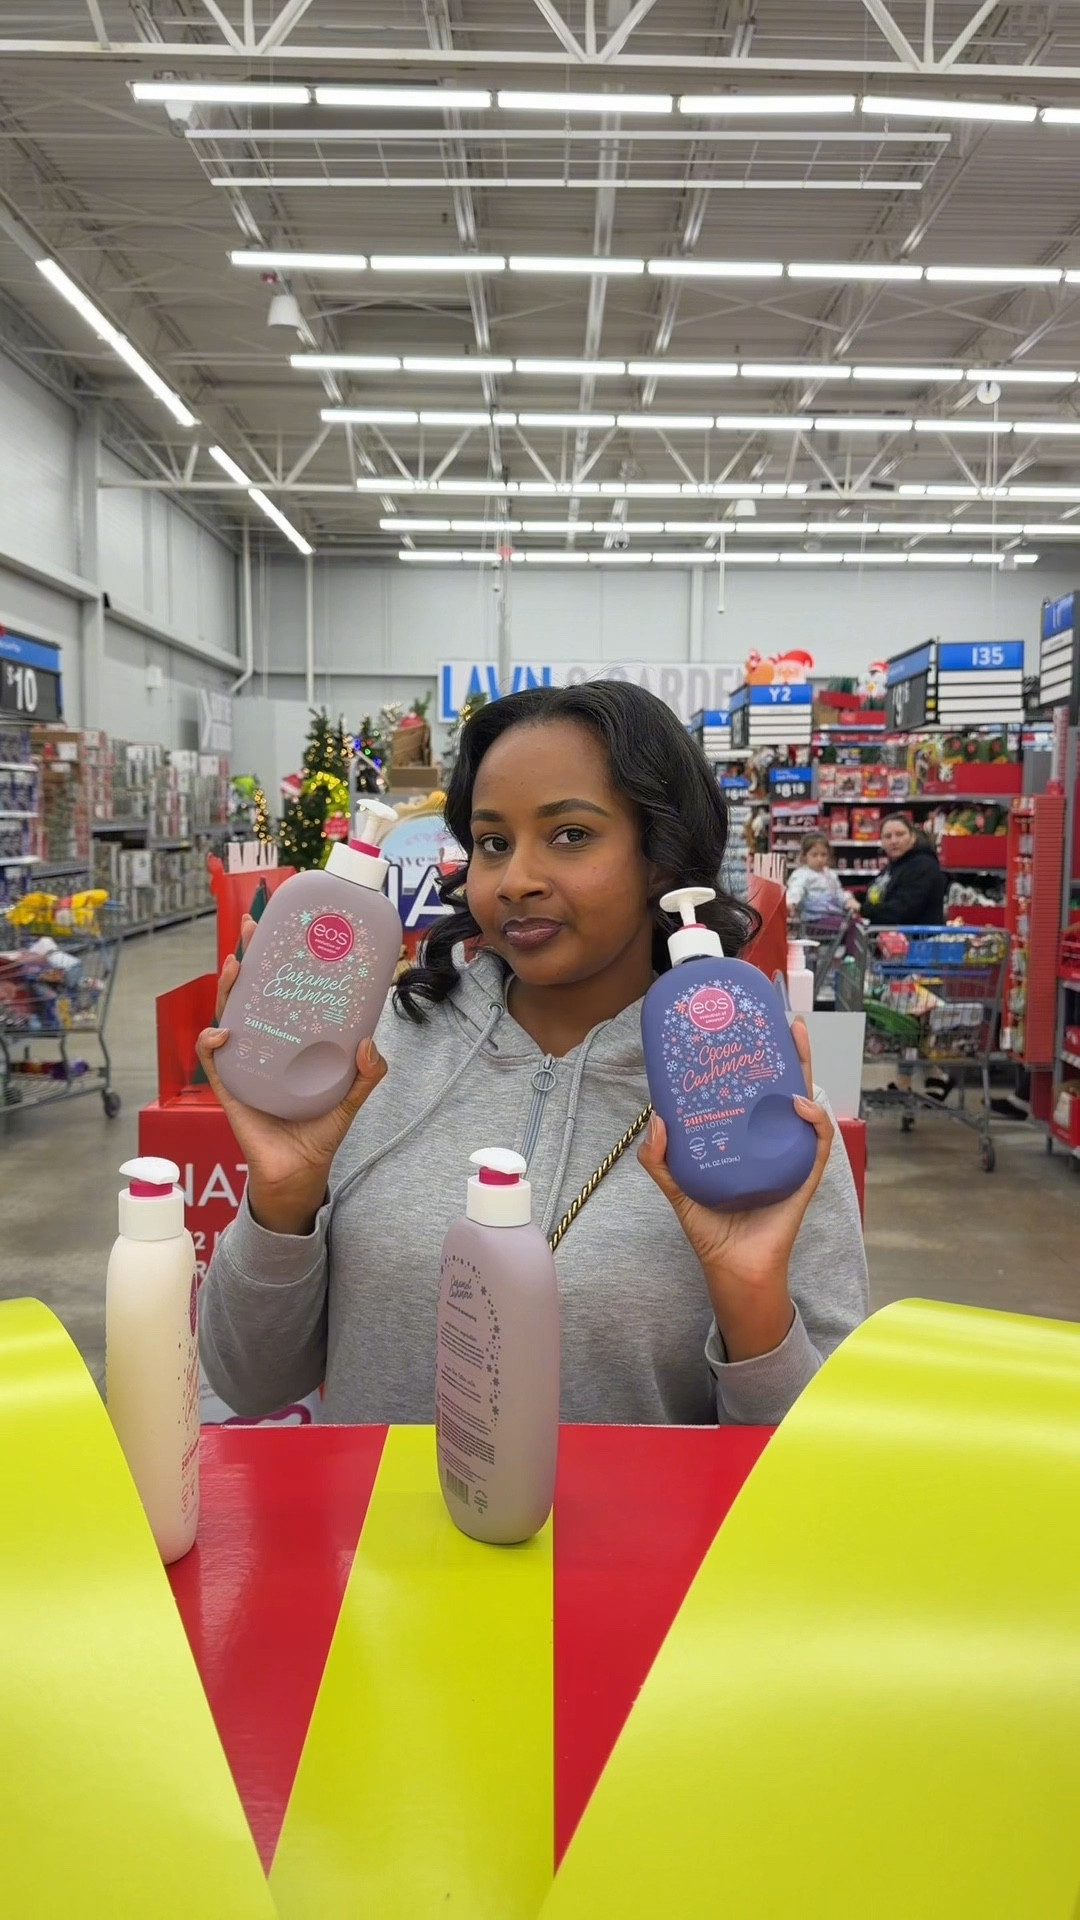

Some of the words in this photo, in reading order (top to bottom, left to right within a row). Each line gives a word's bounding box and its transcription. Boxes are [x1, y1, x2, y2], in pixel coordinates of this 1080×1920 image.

[7, 665, 38, 713] $10
[768, 685, 792, 703] Y2
[313, 923, 349, 946] eos
[276, 963, 352, 991] Caramel
[263, 979, 352, 1006] Cashmere
[692, 997, 729, 1015] eos
[244, 1017, 263, 1031] 24H
[263, 1023, 302, 1044] Moisture
[699, 1041, 743, 1066] Cocoa
[683, 1049, 765, 1092] Cashmere
[683, 1114, 703, 1128] 24H
[703, 1107, 746, 1122] Moisture
[685, 1124, 706, 1135] BODY
[706, 1117, 733, 1130] LOTION
